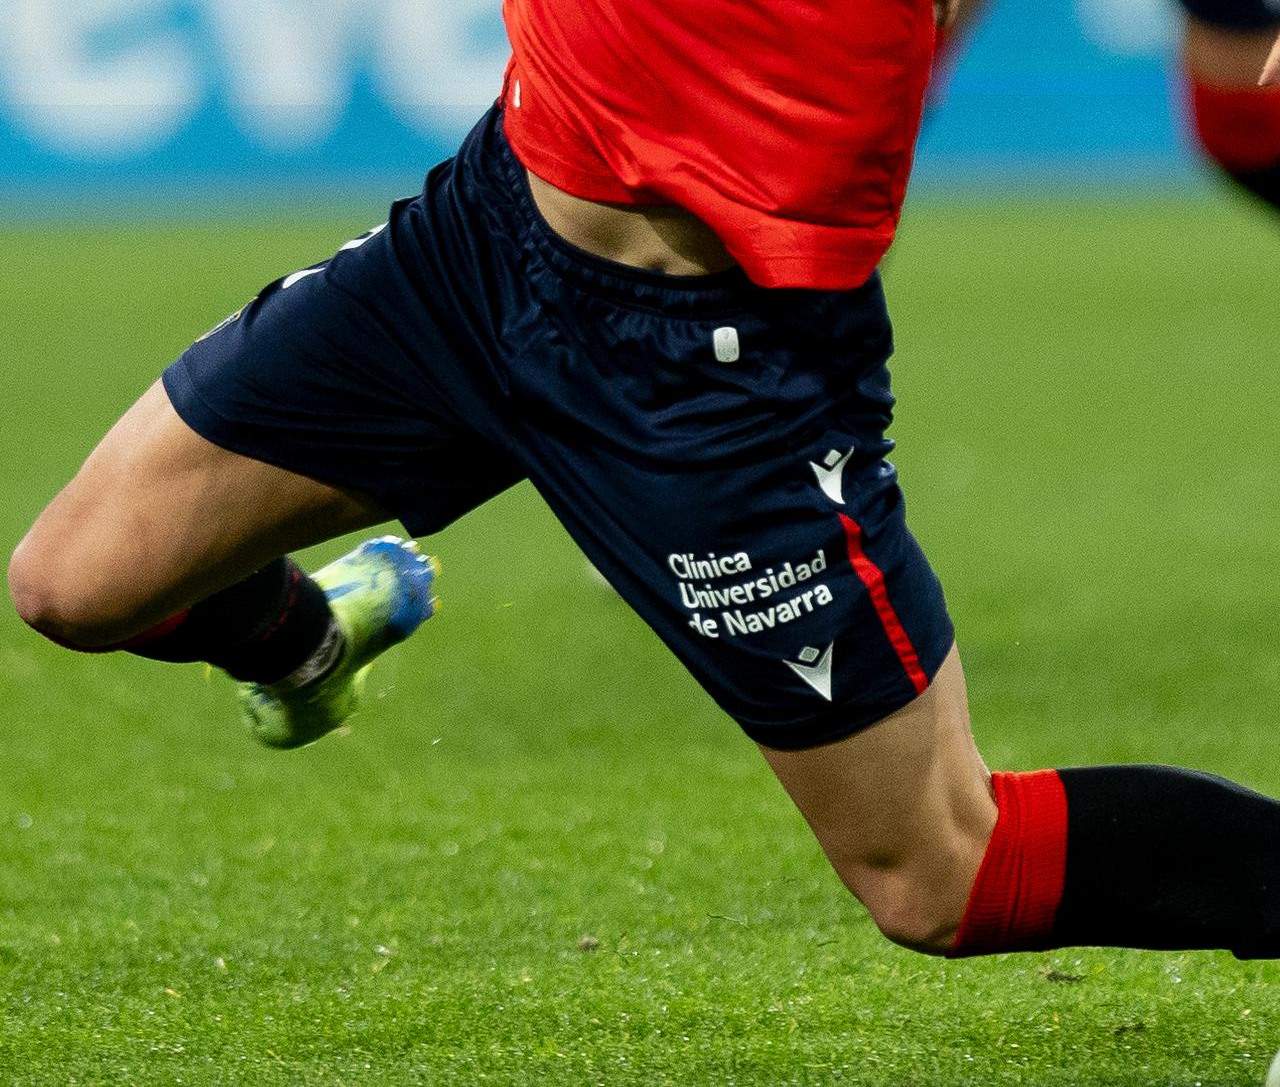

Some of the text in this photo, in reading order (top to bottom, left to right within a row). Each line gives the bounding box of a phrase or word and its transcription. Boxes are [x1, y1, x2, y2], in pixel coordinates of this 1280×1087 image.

[668, 551, 752, 581] Clínica
[679, 549, 827, 609] Universidad
[723, 583, 833, 637] Navarra
